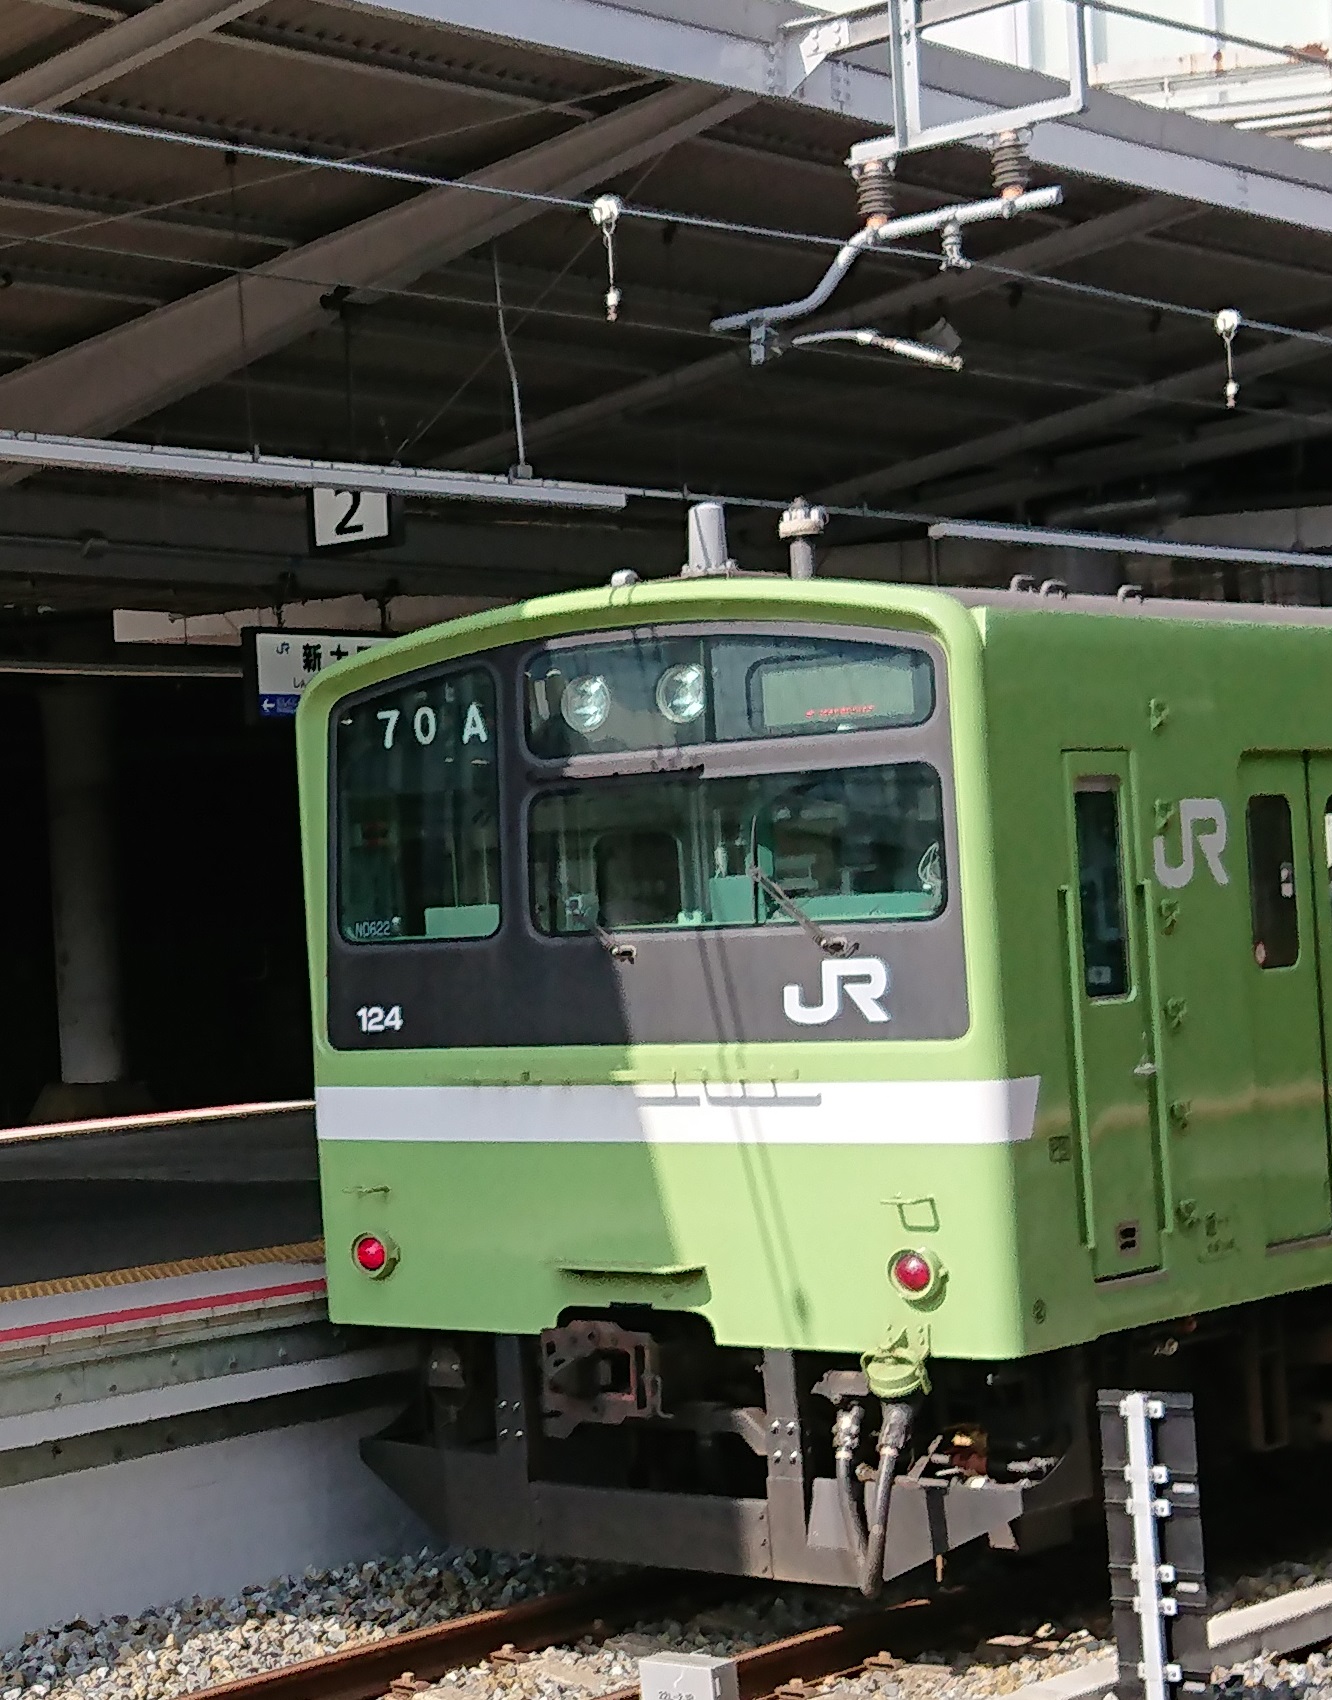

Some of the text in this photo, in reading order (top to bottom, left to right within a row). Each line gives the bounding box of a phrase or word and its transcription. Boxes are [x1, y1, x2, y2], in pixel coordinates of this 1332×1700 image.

[335, 489, 364, 535] 2
[276, 642, 290, 655] JR
[302, 643, 372, 672] 新大
[376, 702, 488, 749] 70 A
[1153, 798, 1229, 888] JR
[783, 958, 891, 1024] JR
[356, 1005, 404, 1032] 124
